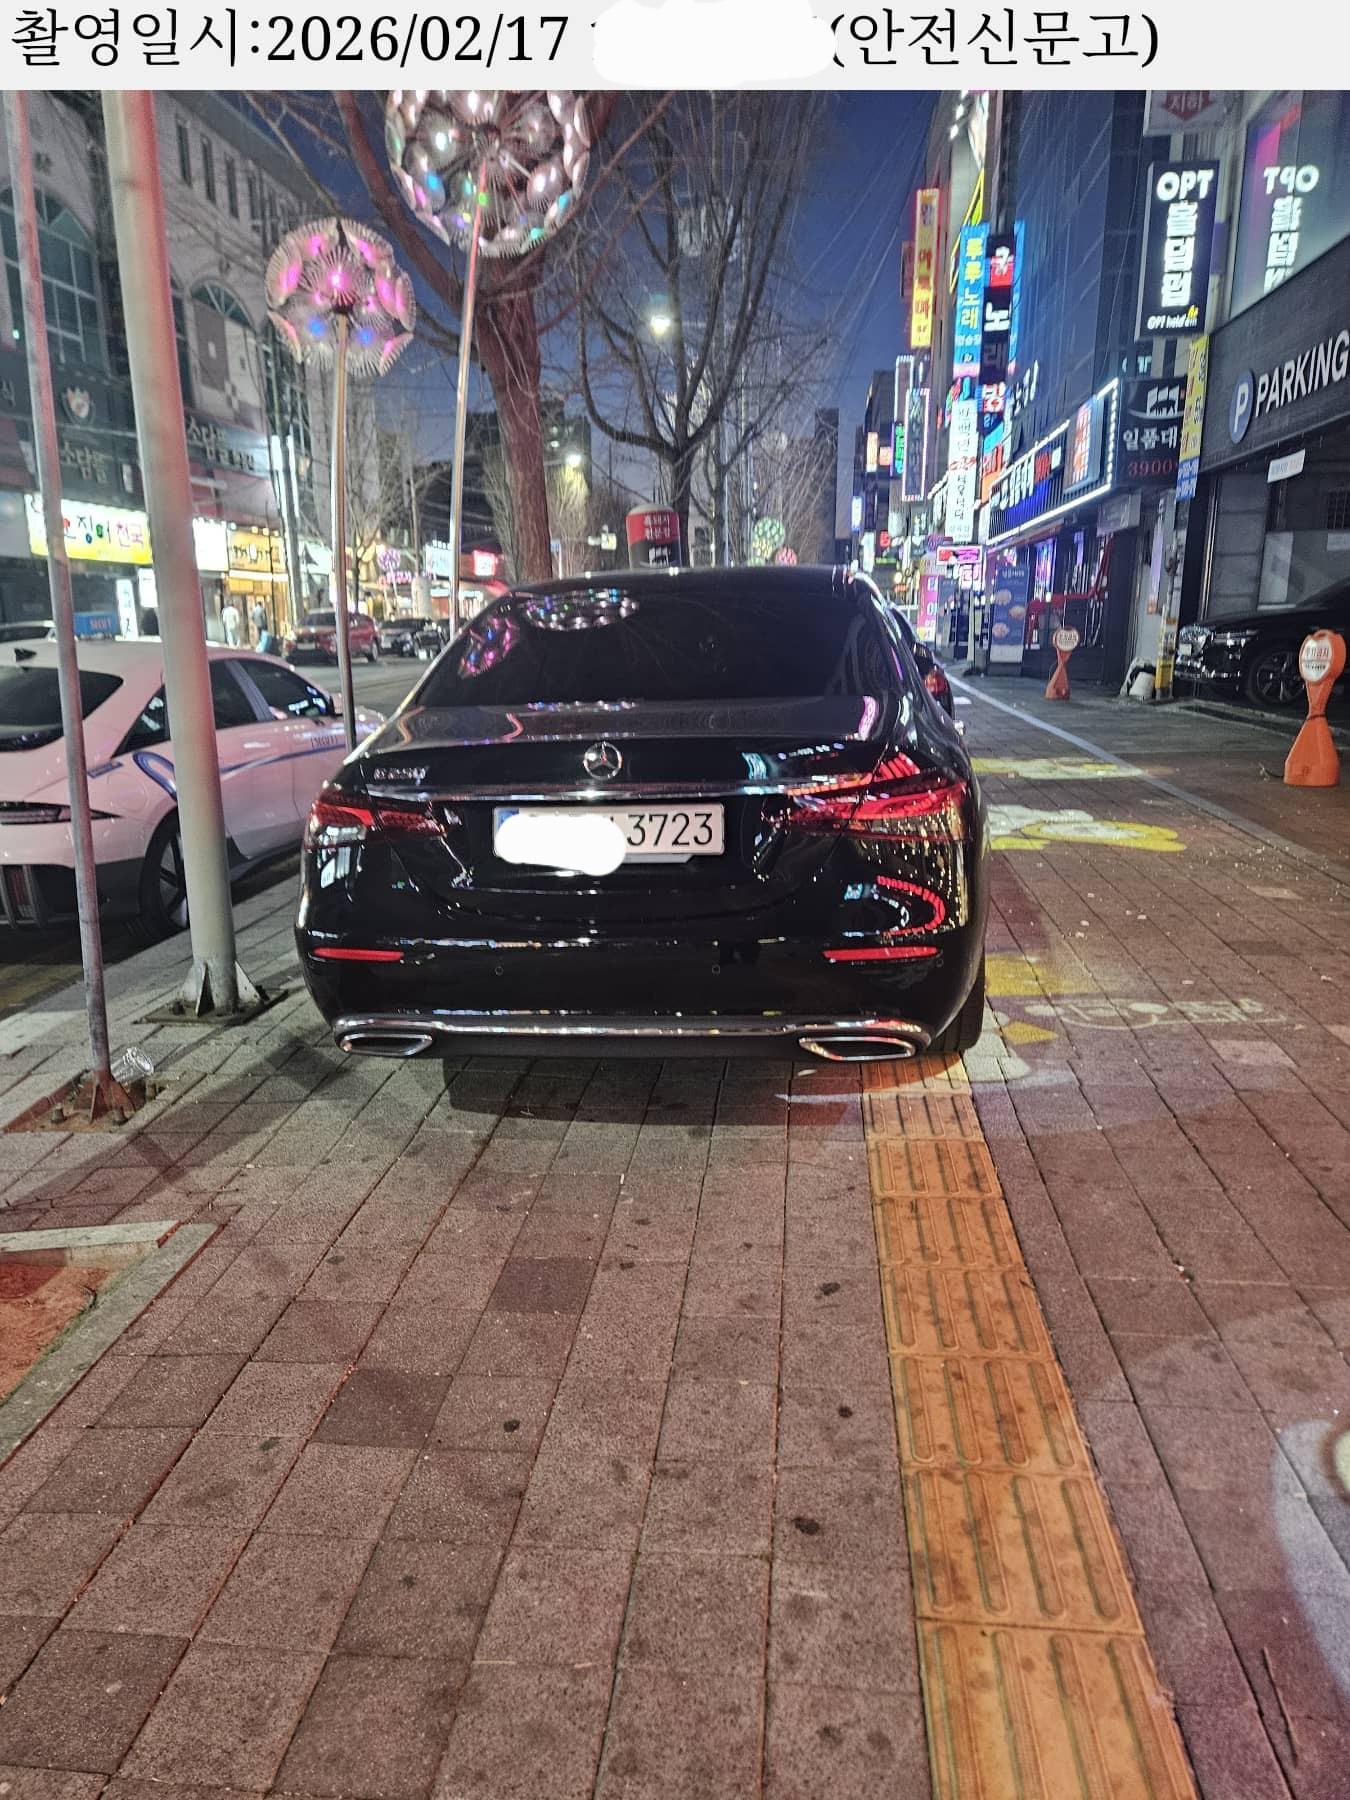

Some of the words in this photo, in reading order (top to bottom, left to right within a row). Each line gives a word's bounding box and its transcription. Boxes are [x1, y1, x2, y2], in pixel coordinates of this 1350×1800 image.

[1157, 169, 1214, 202] OPT
[1256, 329, 1350, 418] PARKING
[1123, 427, 1180, 452] 일품대
[1128, 458, 1178, 478] 3900
[627, 812, 713, 847] 3723
